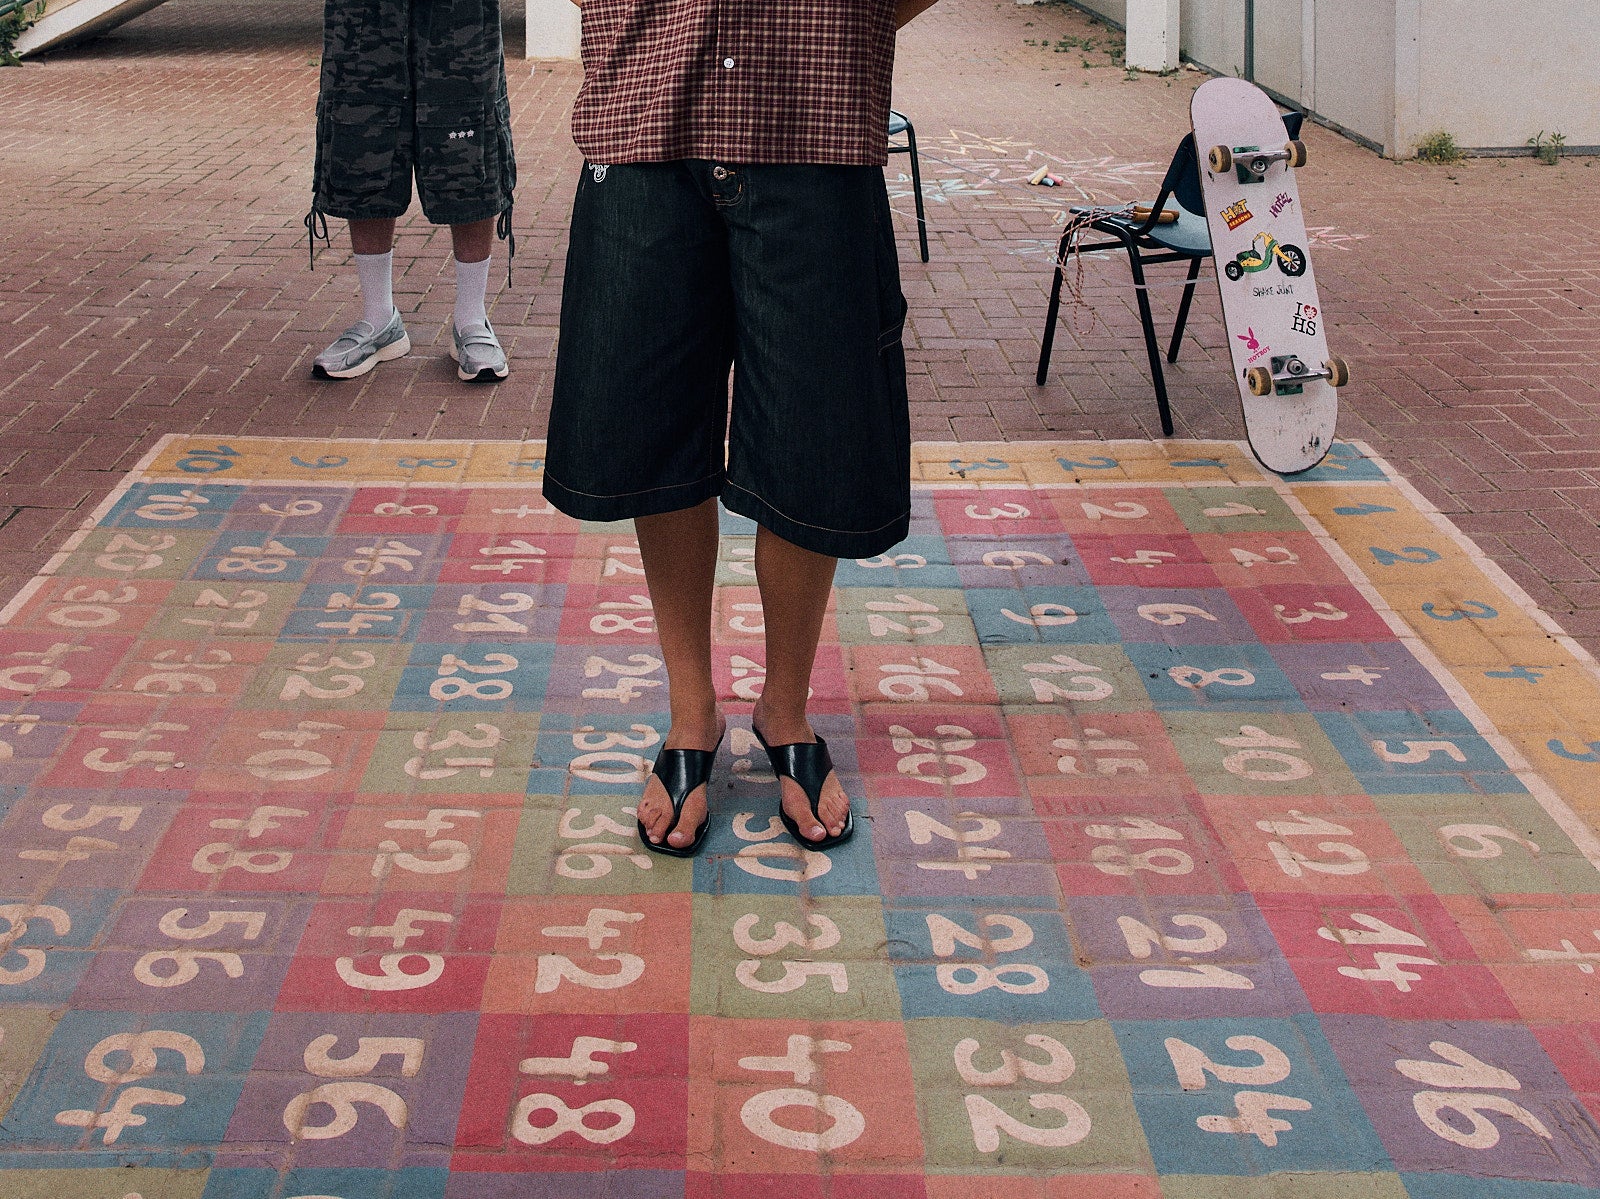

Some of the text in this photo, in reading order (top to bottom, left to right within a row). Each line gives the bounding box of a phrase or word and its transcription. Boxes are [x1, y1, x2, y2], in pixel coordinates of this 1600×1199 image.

[1229, 211, 1252, 227] SEASONS
[1291, 316, 1316, 336] HS
[1295, 301, 1303, 316] I
[1247, 345, 1271, 363] HOTBOY
[177, 445, 242, 474] 10
[290, 455, 349, 470] 9
[399, 457, 457, 470] 8
[948, 457, 1009, 471] 3
[1057, 456, 1119, 472] 2
[1170, 458, 1229, 468] 1
[135, 490, 211, 521] 10
[259, 499, 324, 517] 9
[374, 504, 438, 517] 8
[965, 502, 1030, 520] 3
[1080, 501, 1149, 520] 2
[1203, 502, 1267, 518] 1
[1333, 502, 1396, 515] 1
[95, 533, 177, 572] 20
[217, 540, 297, 574] 18
[342, 540, 423, 576] 16
[470, 539, 547, 574] 14
[982, 551, 1054, 570] 6
[1110, 549, 1177, 568] 4
[1230, 546, 1300, 568] 2
[1369, 546, 1441, 566] 2
[47, 585, 138, 628] 30
[182, 589, 269, 630] 27
[315, 592, 401, 635] 24
[453, 592, 535, 633] 21
[590, 594, 658, 634] 18
[864, 594, 944, 637] 12
[1001, 603, 1079, 627] 9
[1137, 603, 1218, 627] 6
[1274, 601, 1349, 623] 3
[1421, 600, 1500, 622] 3
[0, 642, 94, 692] 40
[133, 649, 233, 698] 36
[280, 650, 376, 700] 32
[429, 653, 519, 701] 28
[582, 653, 664, 704] 24
[878, 656, 964, 702] 16
[1022, 655, 1115, 702] 12
[1168, 663, 1256, 688] 8
[1320, 664, 1391, 685] 4
[1484, 665, 1552, 684] 4
[83, 721, 191, 773] 45
[245, 721, 346, 781] 40
[404, 723, 500, 780] 35
[570, 723, 661, 785] 30
[889, 724, 988, 786] 20
[1052, 728, 1149, 776] 15
[1215, 725, 1314, 782] 10
[1373, 739, 1467, 763] 5
[18, 803, 143, 863] 54
[192, 805, 310, 875] 48
[371, 808, 481, 875] 42
[555, 807, 653, 880] 36
[905, 810, 1012, 881] 24
[1084, 816, 1195, 876] 18
[1256, 810, 1372, 878] 12
[1438, 823, 1541, 859] 6
[133, 907, 267, 988] 56
[335, 907, 453, 992] 49
[535, 908, 646, 994] 42
[733, 912, 849, 995] 35
[926, 914, 1050, 995] 28
[1117, 914, 1255, 990] 21
[1318, 912, 1439, 993] 14
[55, 1030, 206, 1146] 64
[283, 1033, 425, 1141] 56
[512, 1035, 638, 1146] 48
[737, 1033, 866, 1152] 40
[953, 1034, 1092, 1154] 32
[1164, 1034, 1312, 1148] 24
[1395, 1040, 1553, 1150] 16
